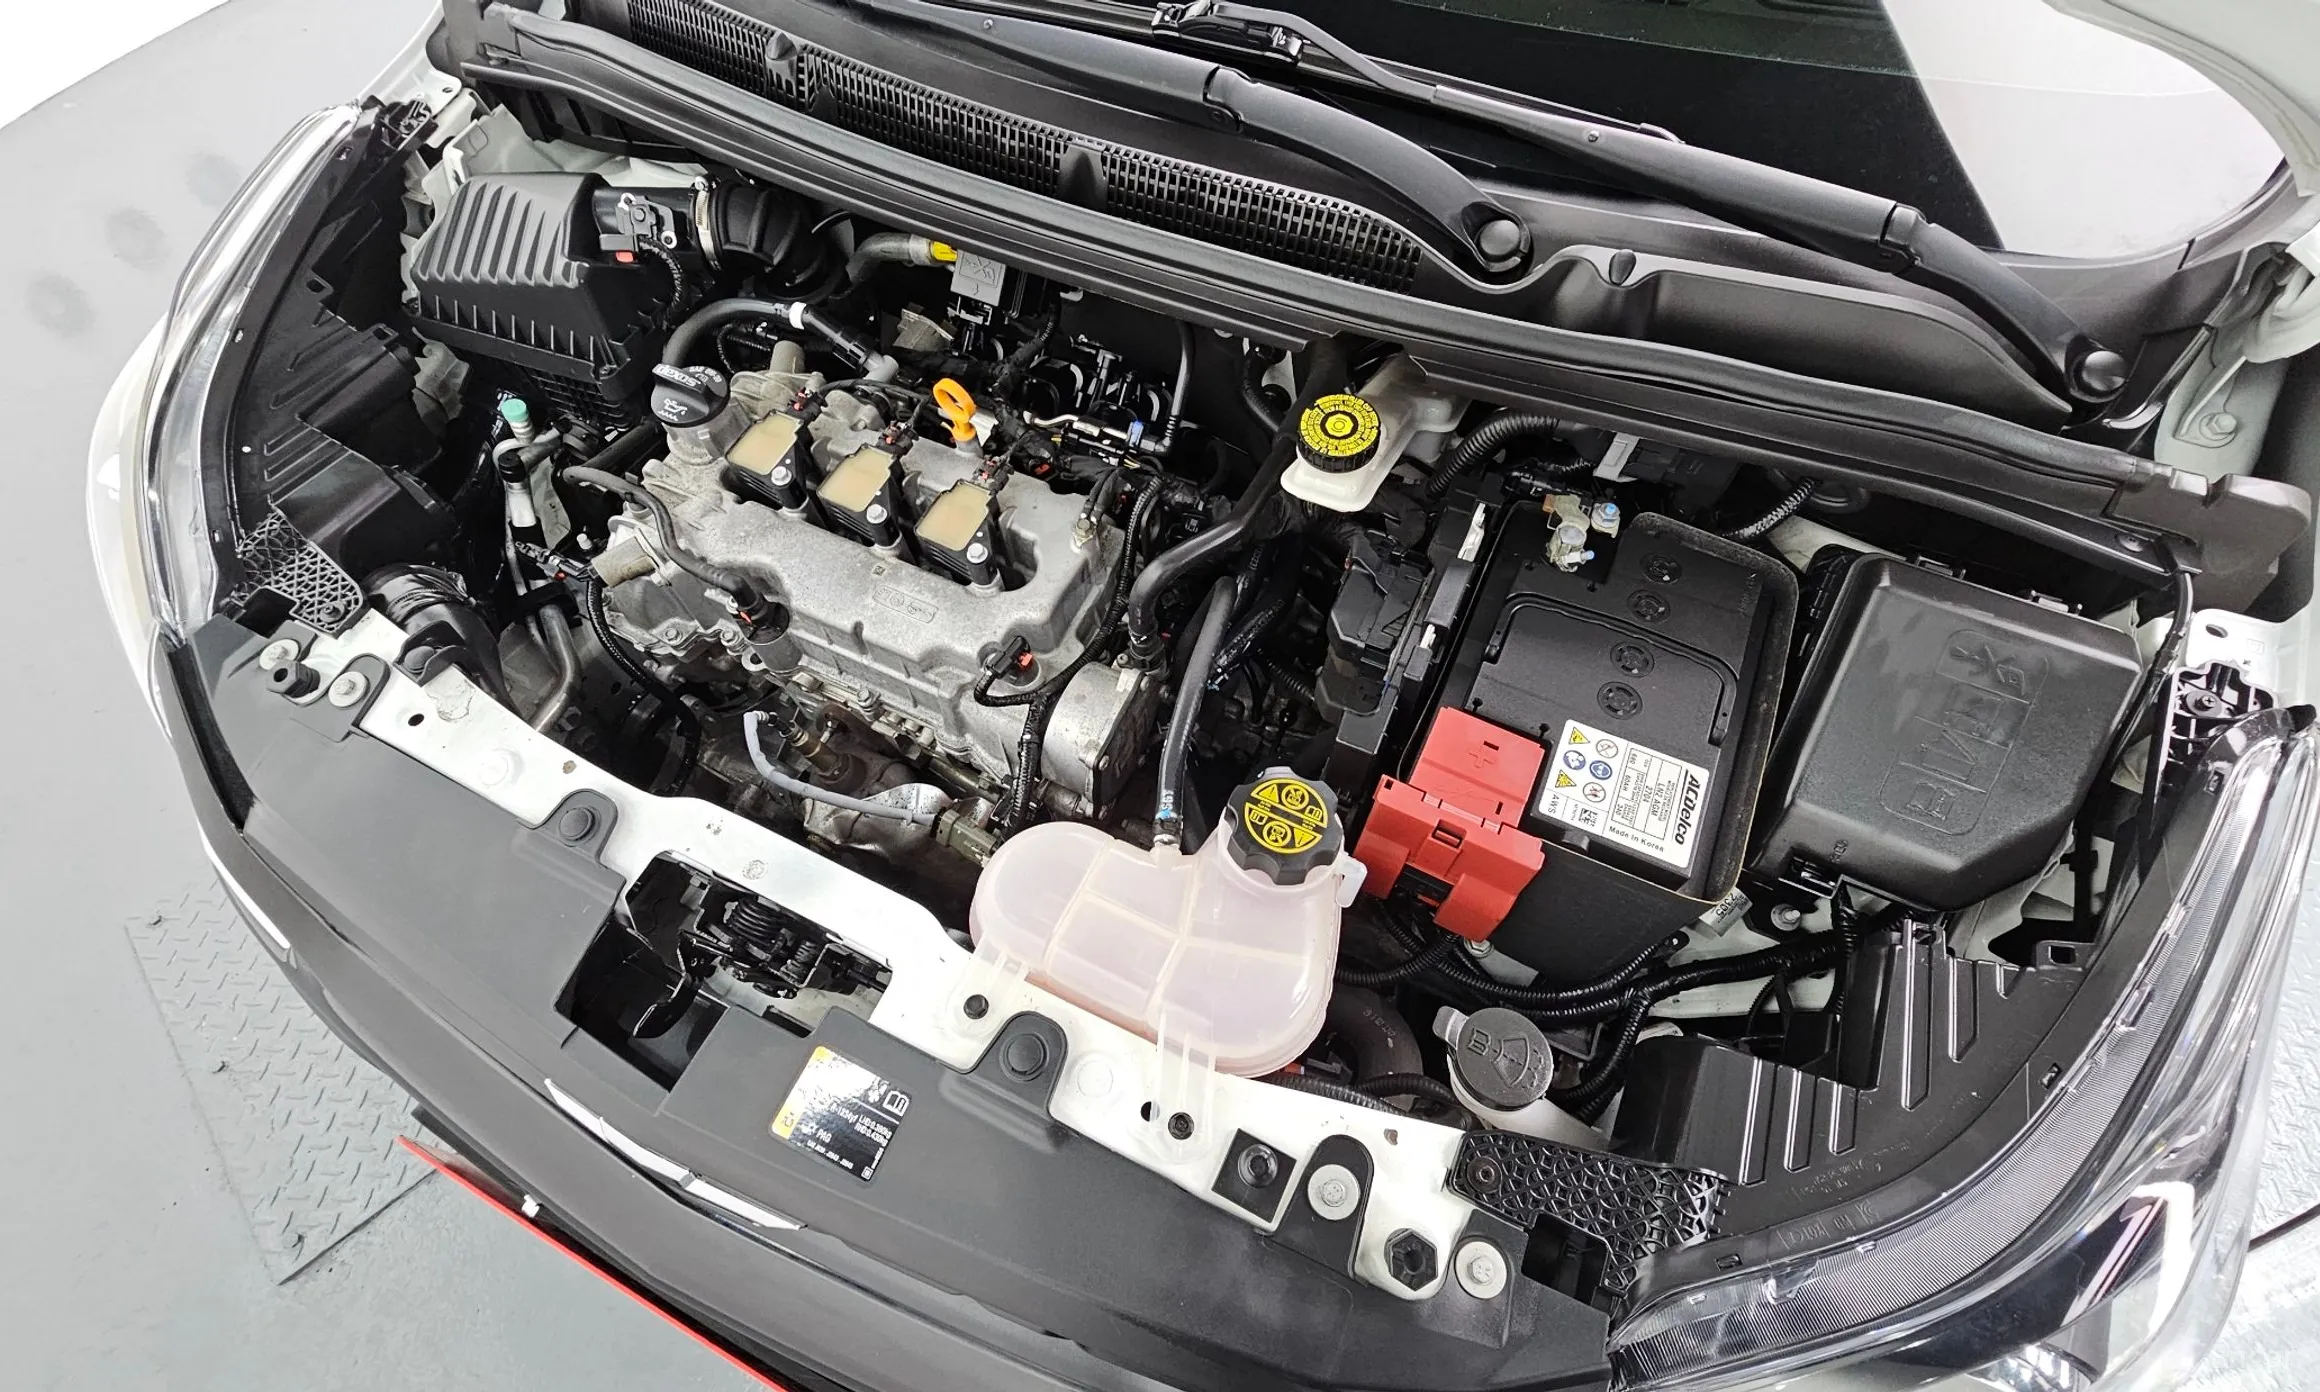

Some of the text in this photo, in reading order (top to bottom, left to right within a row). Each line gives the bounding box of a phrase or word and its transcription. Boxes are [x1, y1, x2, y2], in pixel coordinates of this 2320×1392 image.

[1643, 785, 1653, 803] 2704
[1654, 783, 1666, 799] LN2
[1548, 794, 1559, 814] AWS
[1651, 799, 1661, 817] AGM
[1674, 773, 1701, 845] ACDelco
[1609, 826, 1630, 837] Made
[1641, 838, 1664, 852] Korea
[1715, 892, 1736, 916] 2305
[816, 1128, 832, 1144] PAG
